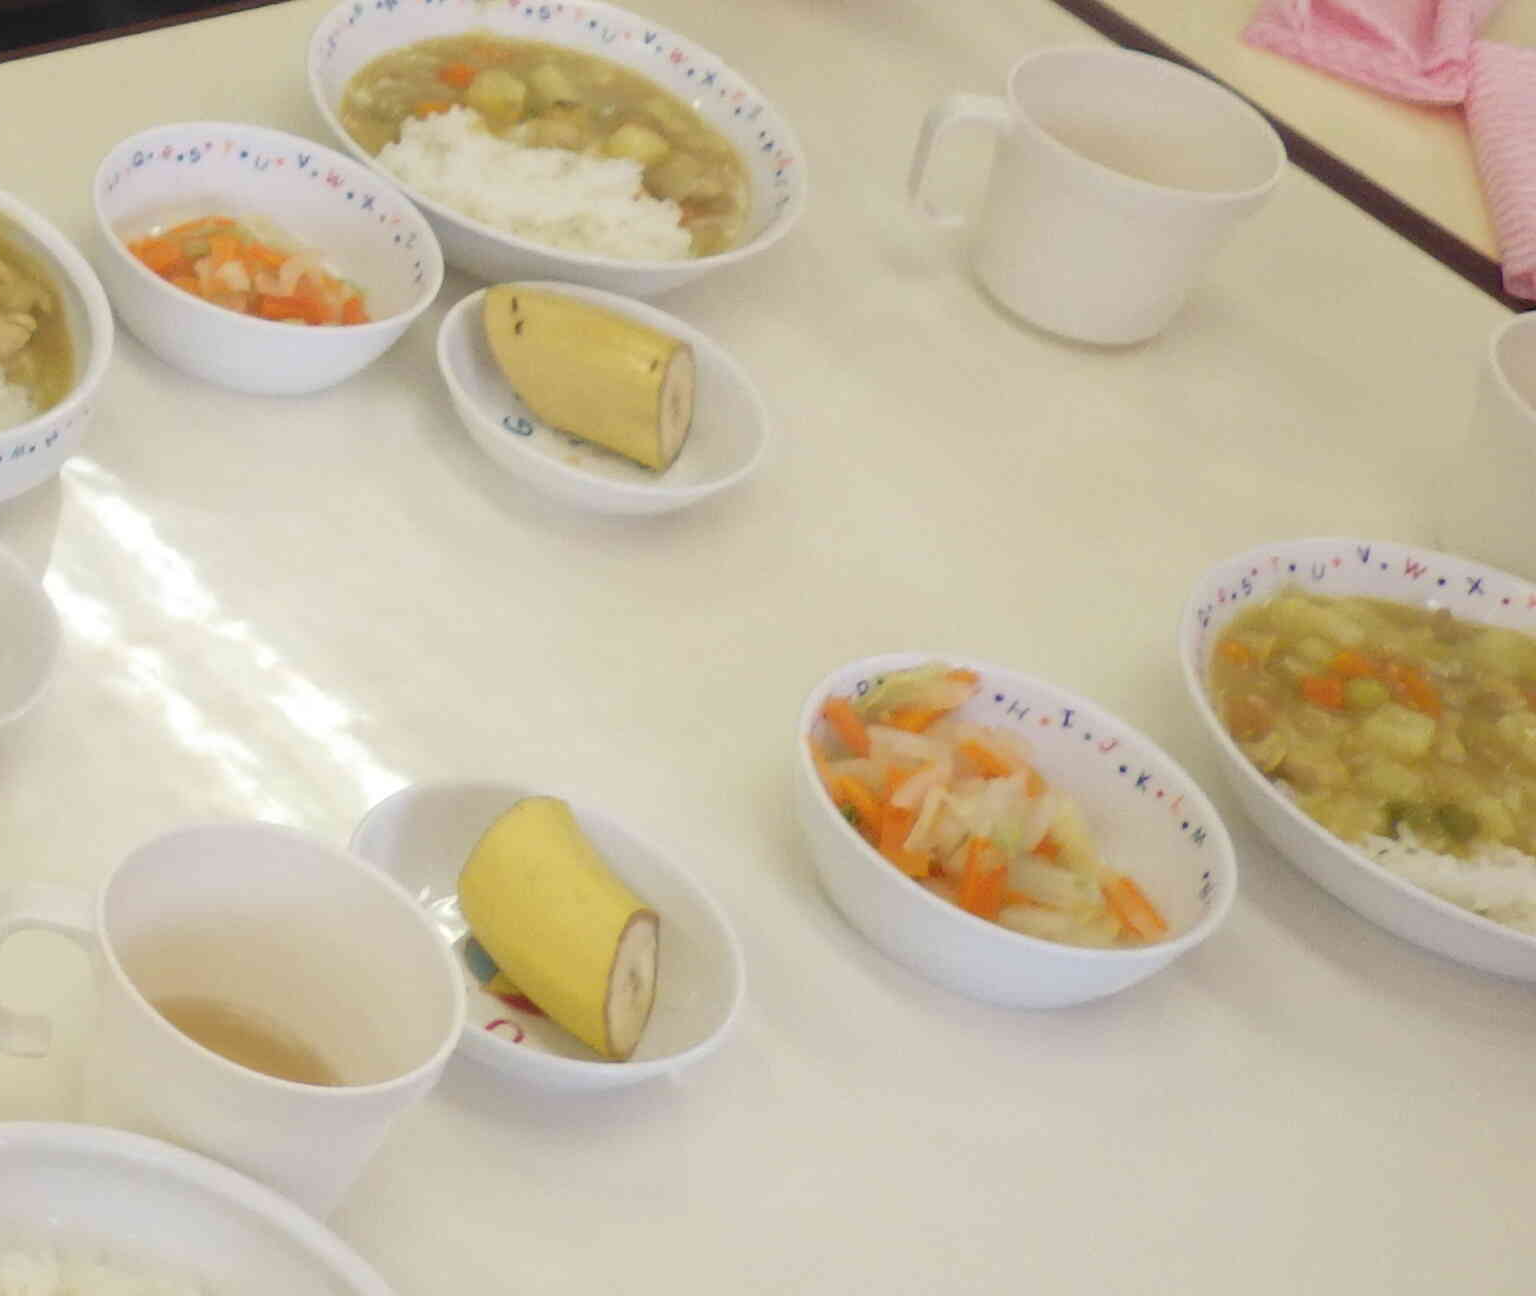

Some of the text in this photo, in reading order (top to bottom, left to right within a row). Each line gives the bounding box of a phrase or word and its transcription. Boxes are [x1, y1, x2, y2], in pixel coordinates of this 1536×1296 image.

[1311, 560, 1328, 581] U
[1405, 557, 1428, 580] W
[1465, 576, 1485, 596] X
[1006, 700, 1031, 721] H
[1062, 708, 1075, 729] I
